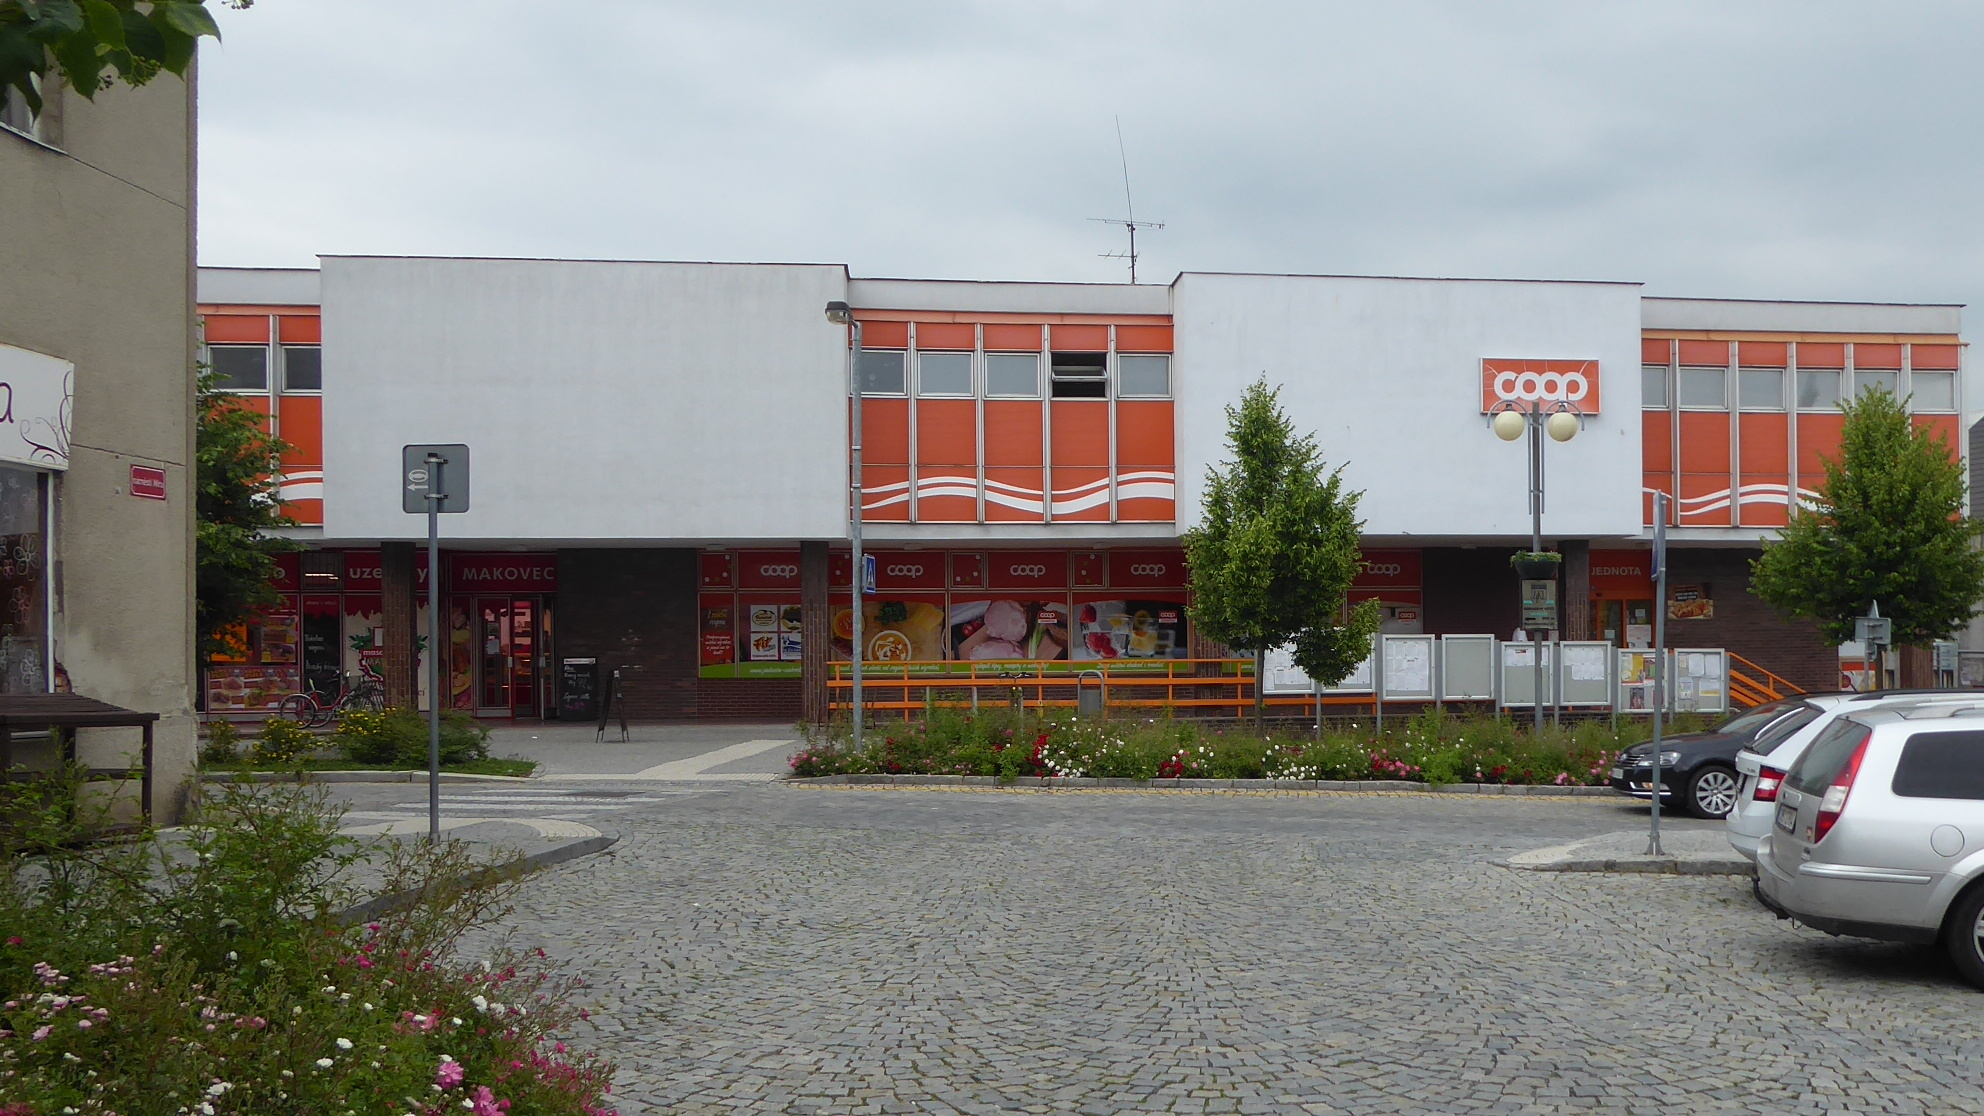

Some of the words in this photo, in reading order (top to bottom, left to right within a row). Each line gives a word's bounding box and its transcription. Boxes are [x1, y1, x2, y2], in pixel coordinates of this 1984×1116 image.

[1494, 371, 1588, 408] coop
[462, 567, 555, 580] MAKOVEC
[760, 564, 798, 579] coop
[887, 564, 923, 579] coop
[1009, 564, 1046, 578] coop
[1130, 563, 1166, 577] coop
[1591, 566, 1641, 576] JEDNOTA
